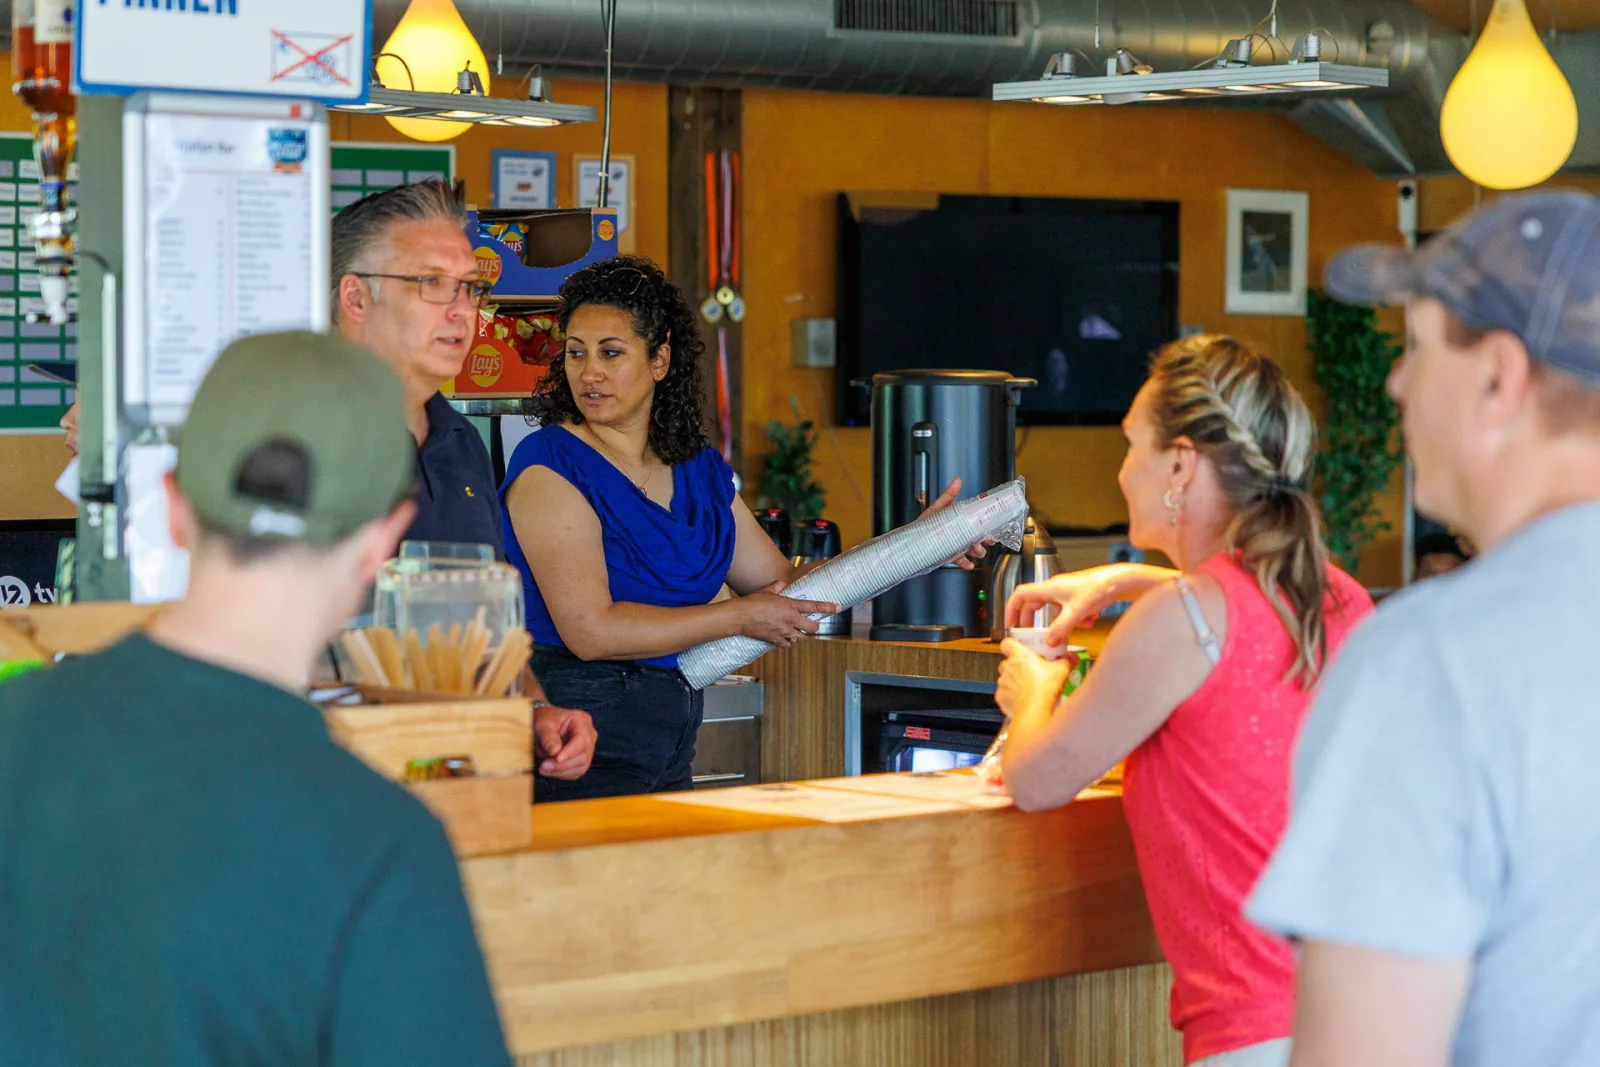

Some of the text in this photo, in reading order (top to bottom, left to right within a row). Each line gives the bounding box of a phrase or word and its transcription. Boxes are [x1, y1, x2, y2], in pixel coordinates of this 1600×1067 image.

[476, 257, 500, 278] ay's
[471, 353, 500, 376] Lay's
[34, 582, 59, 603] tv
